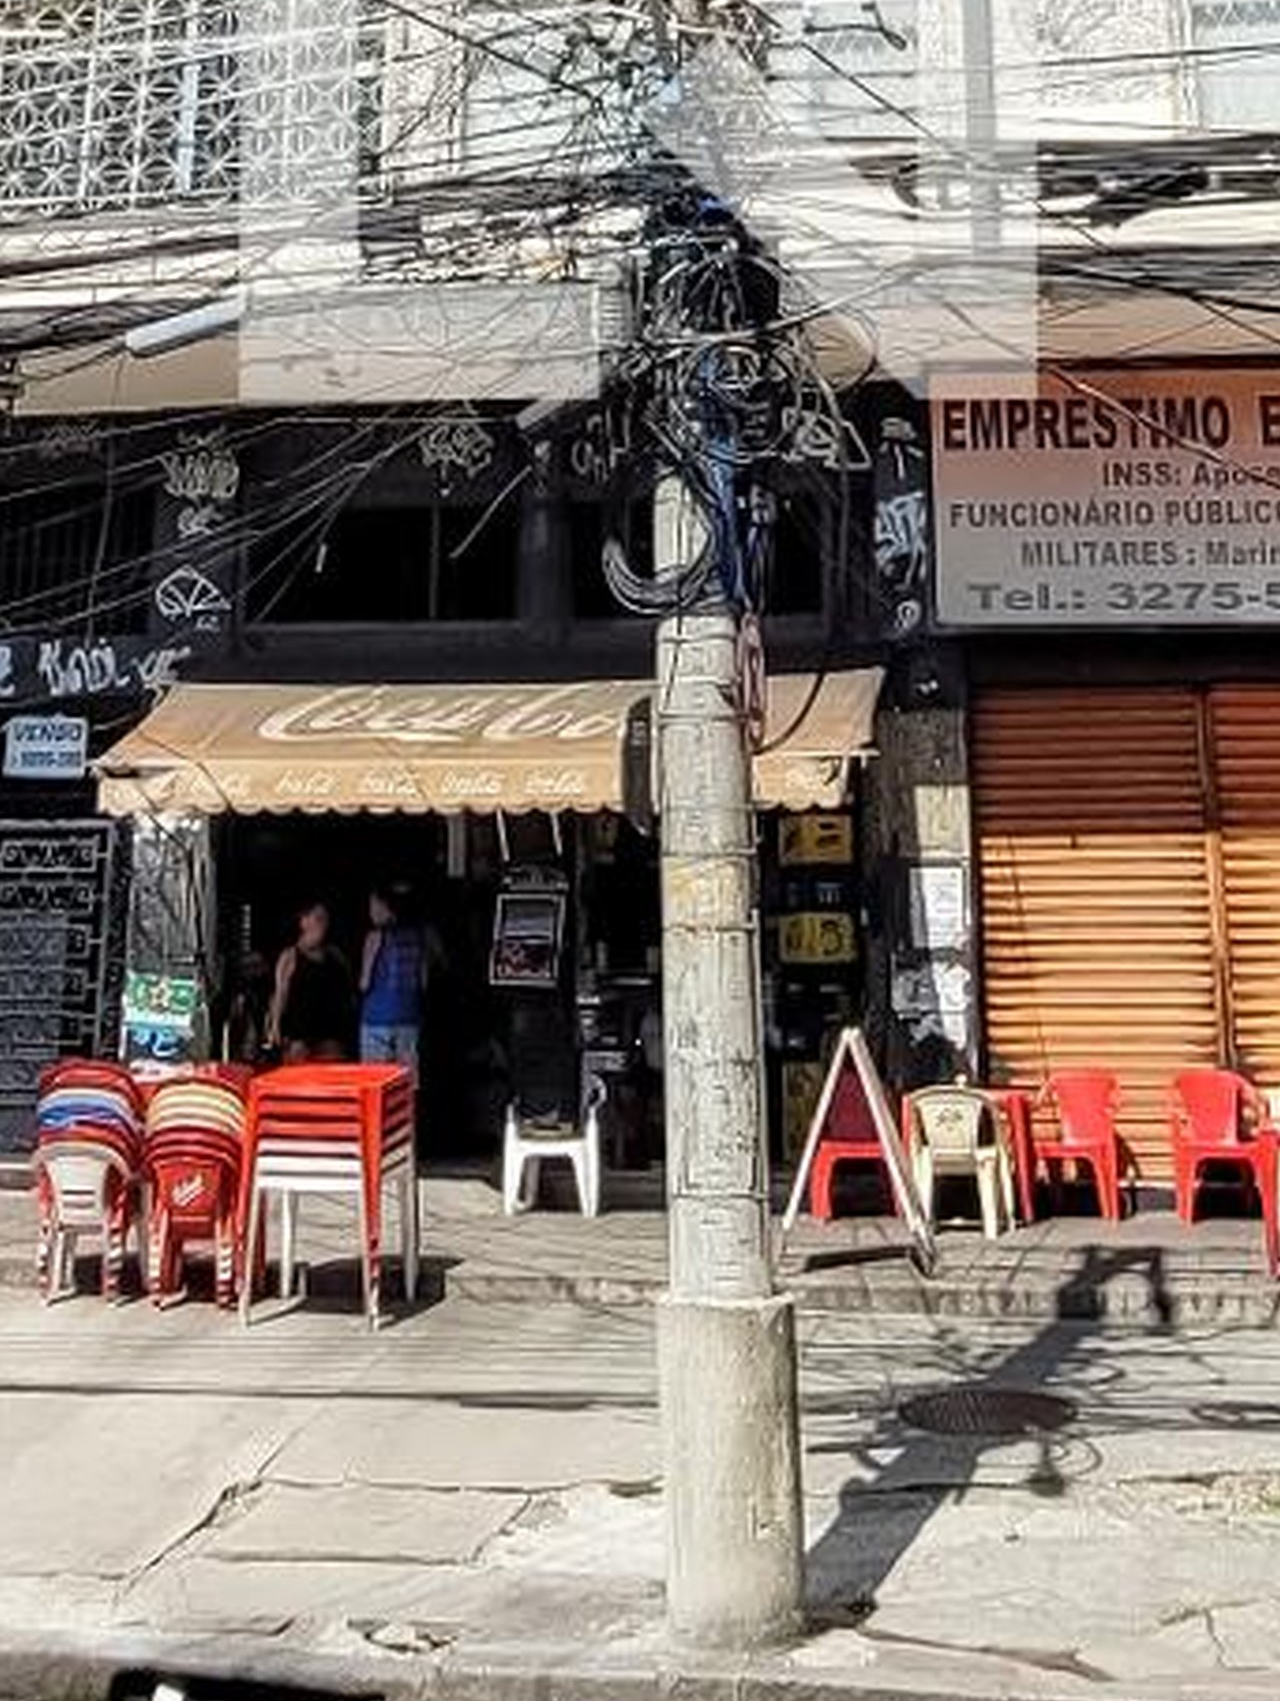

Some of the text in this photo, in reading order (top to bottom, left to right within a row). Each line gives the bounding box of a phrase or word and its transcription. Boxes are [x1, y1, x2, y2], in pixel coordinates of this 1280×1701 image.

[1102, 462, 1183, 488] INSS:
[949, 495, 1155, 529] FUNCIONÁRIO
[966, 581, 1086, 612] Tel.:
